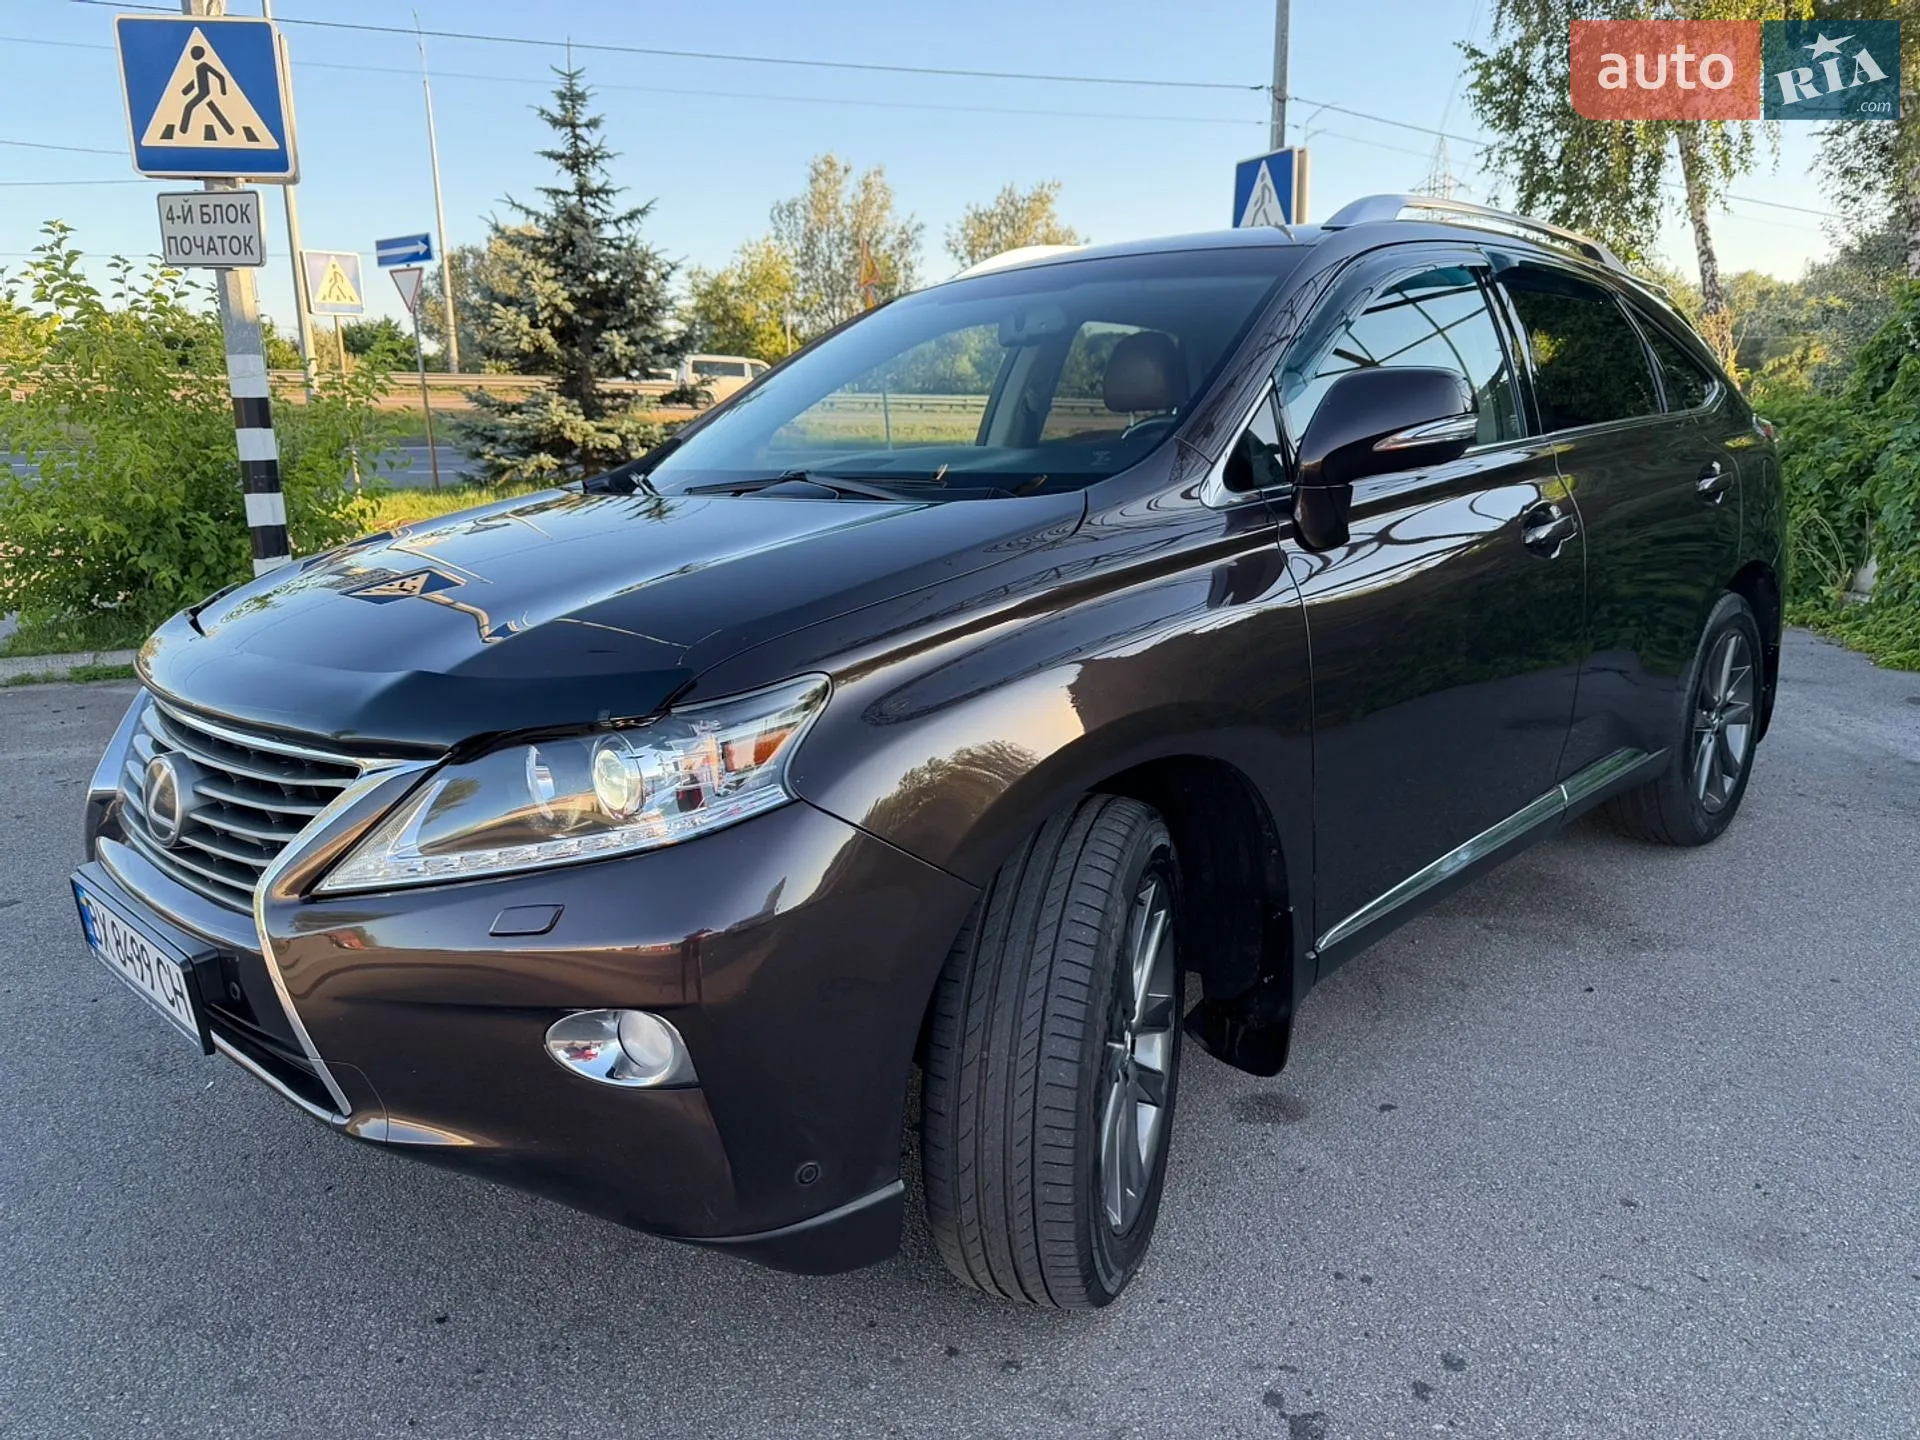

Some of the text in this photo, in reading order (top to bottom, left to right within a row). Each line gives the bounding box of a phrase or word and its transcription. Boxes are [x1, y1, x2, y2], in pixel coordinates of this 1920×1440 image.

[166, 199, 251, 225] 4-Й БЛОК
[167, 235, 255, 256] ПОЧАТОК
[110, 919, 155, 991] 8499
[156, 956, 193, 1023] CH
